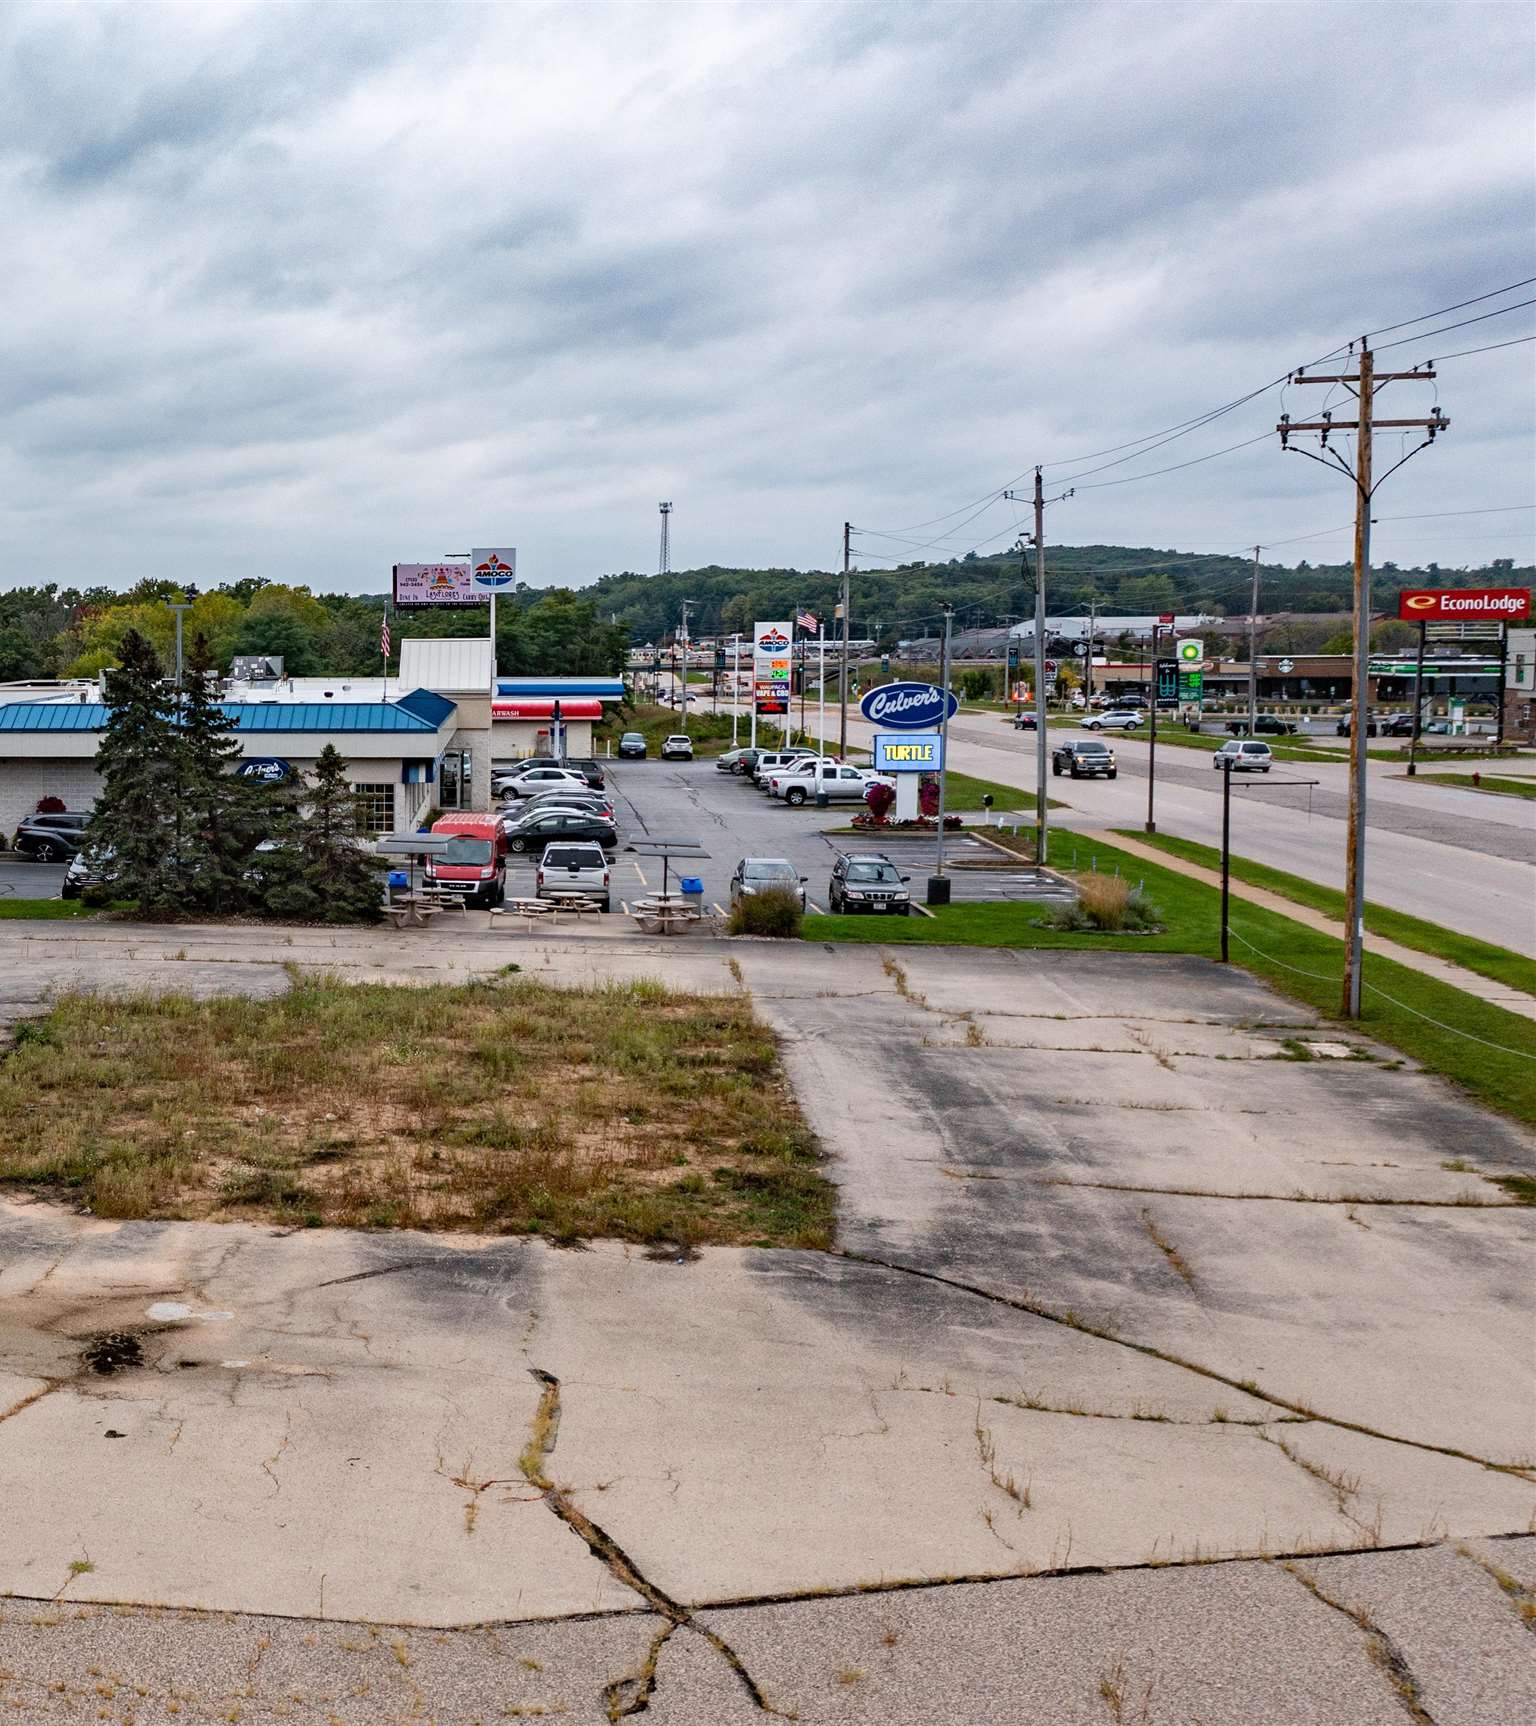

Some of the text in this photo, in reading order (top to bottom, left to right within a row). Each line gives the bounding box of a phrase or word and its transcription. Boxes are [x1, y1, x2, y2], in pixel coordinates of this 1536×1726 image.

[1440, 595, 1526, 612] EconoLodge
[756, 689, 789, 697] VAPE & CBD
[869, 687, 940, 719] Culver's
[883, 744, 934, 761] TURTLE
